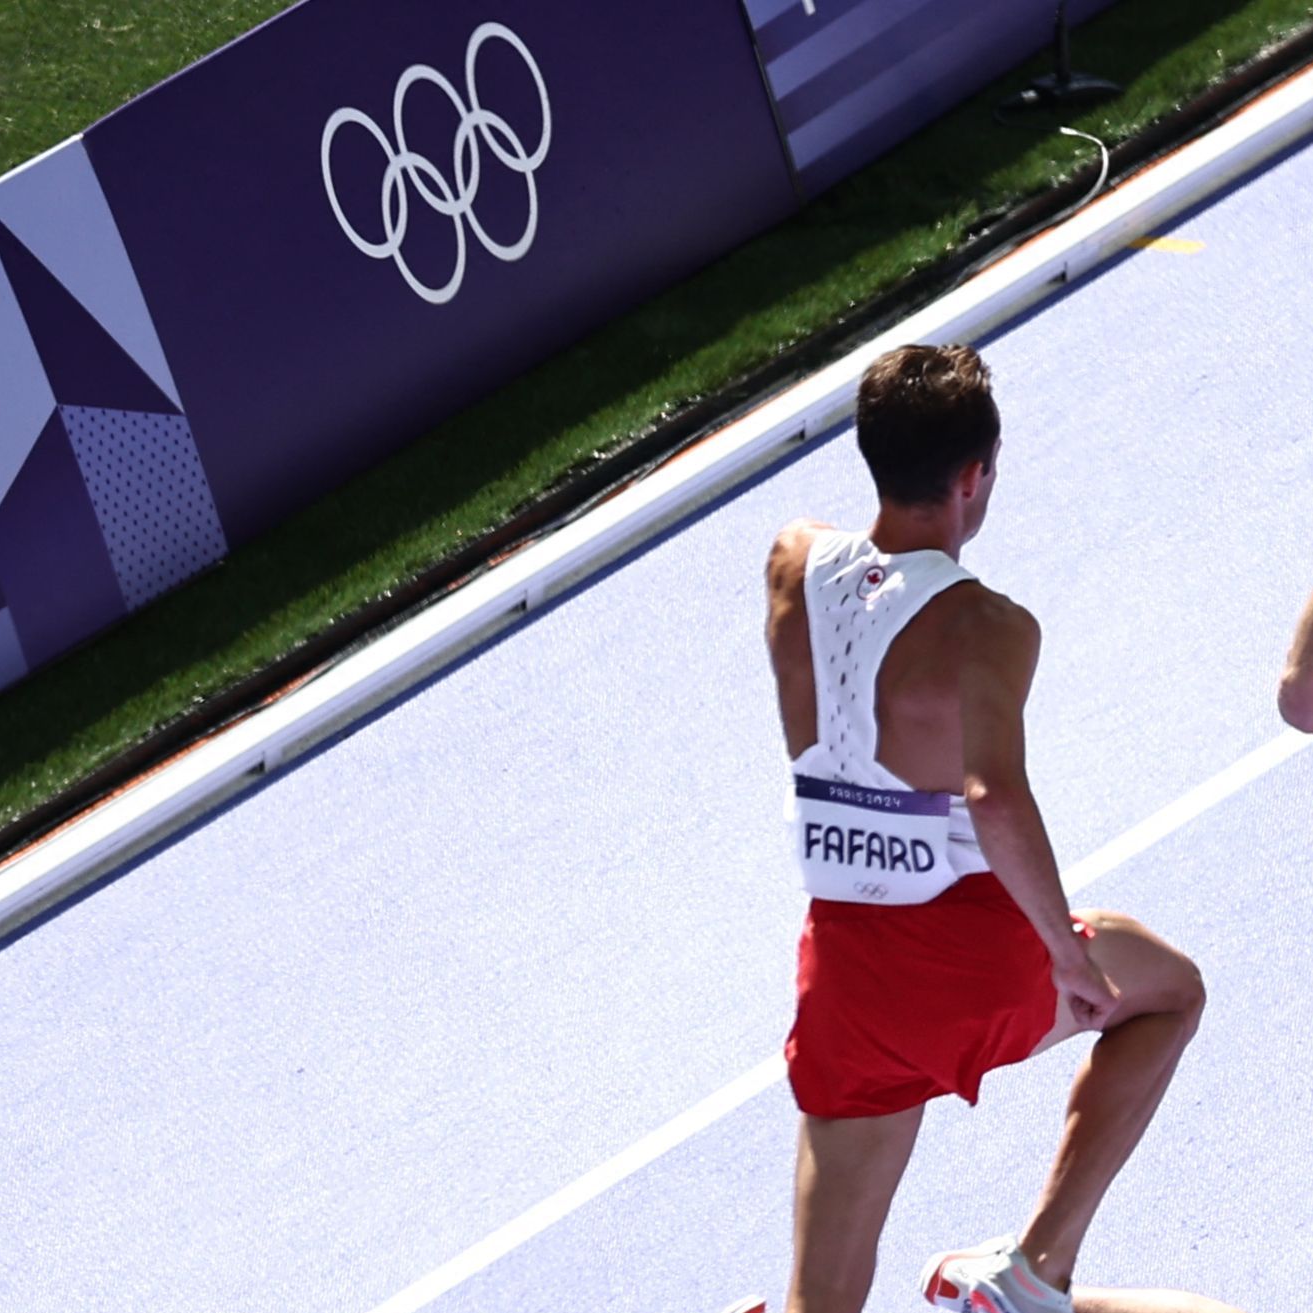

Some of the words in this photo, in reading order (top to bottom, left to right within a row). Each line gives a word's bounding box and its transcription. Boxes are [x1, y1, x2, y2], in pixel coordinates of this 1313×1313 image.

[829, 785, 863, 802] PARIS
[865, 793, 901, 808] 2024
[805, 823, 935, 873] FAFARD
